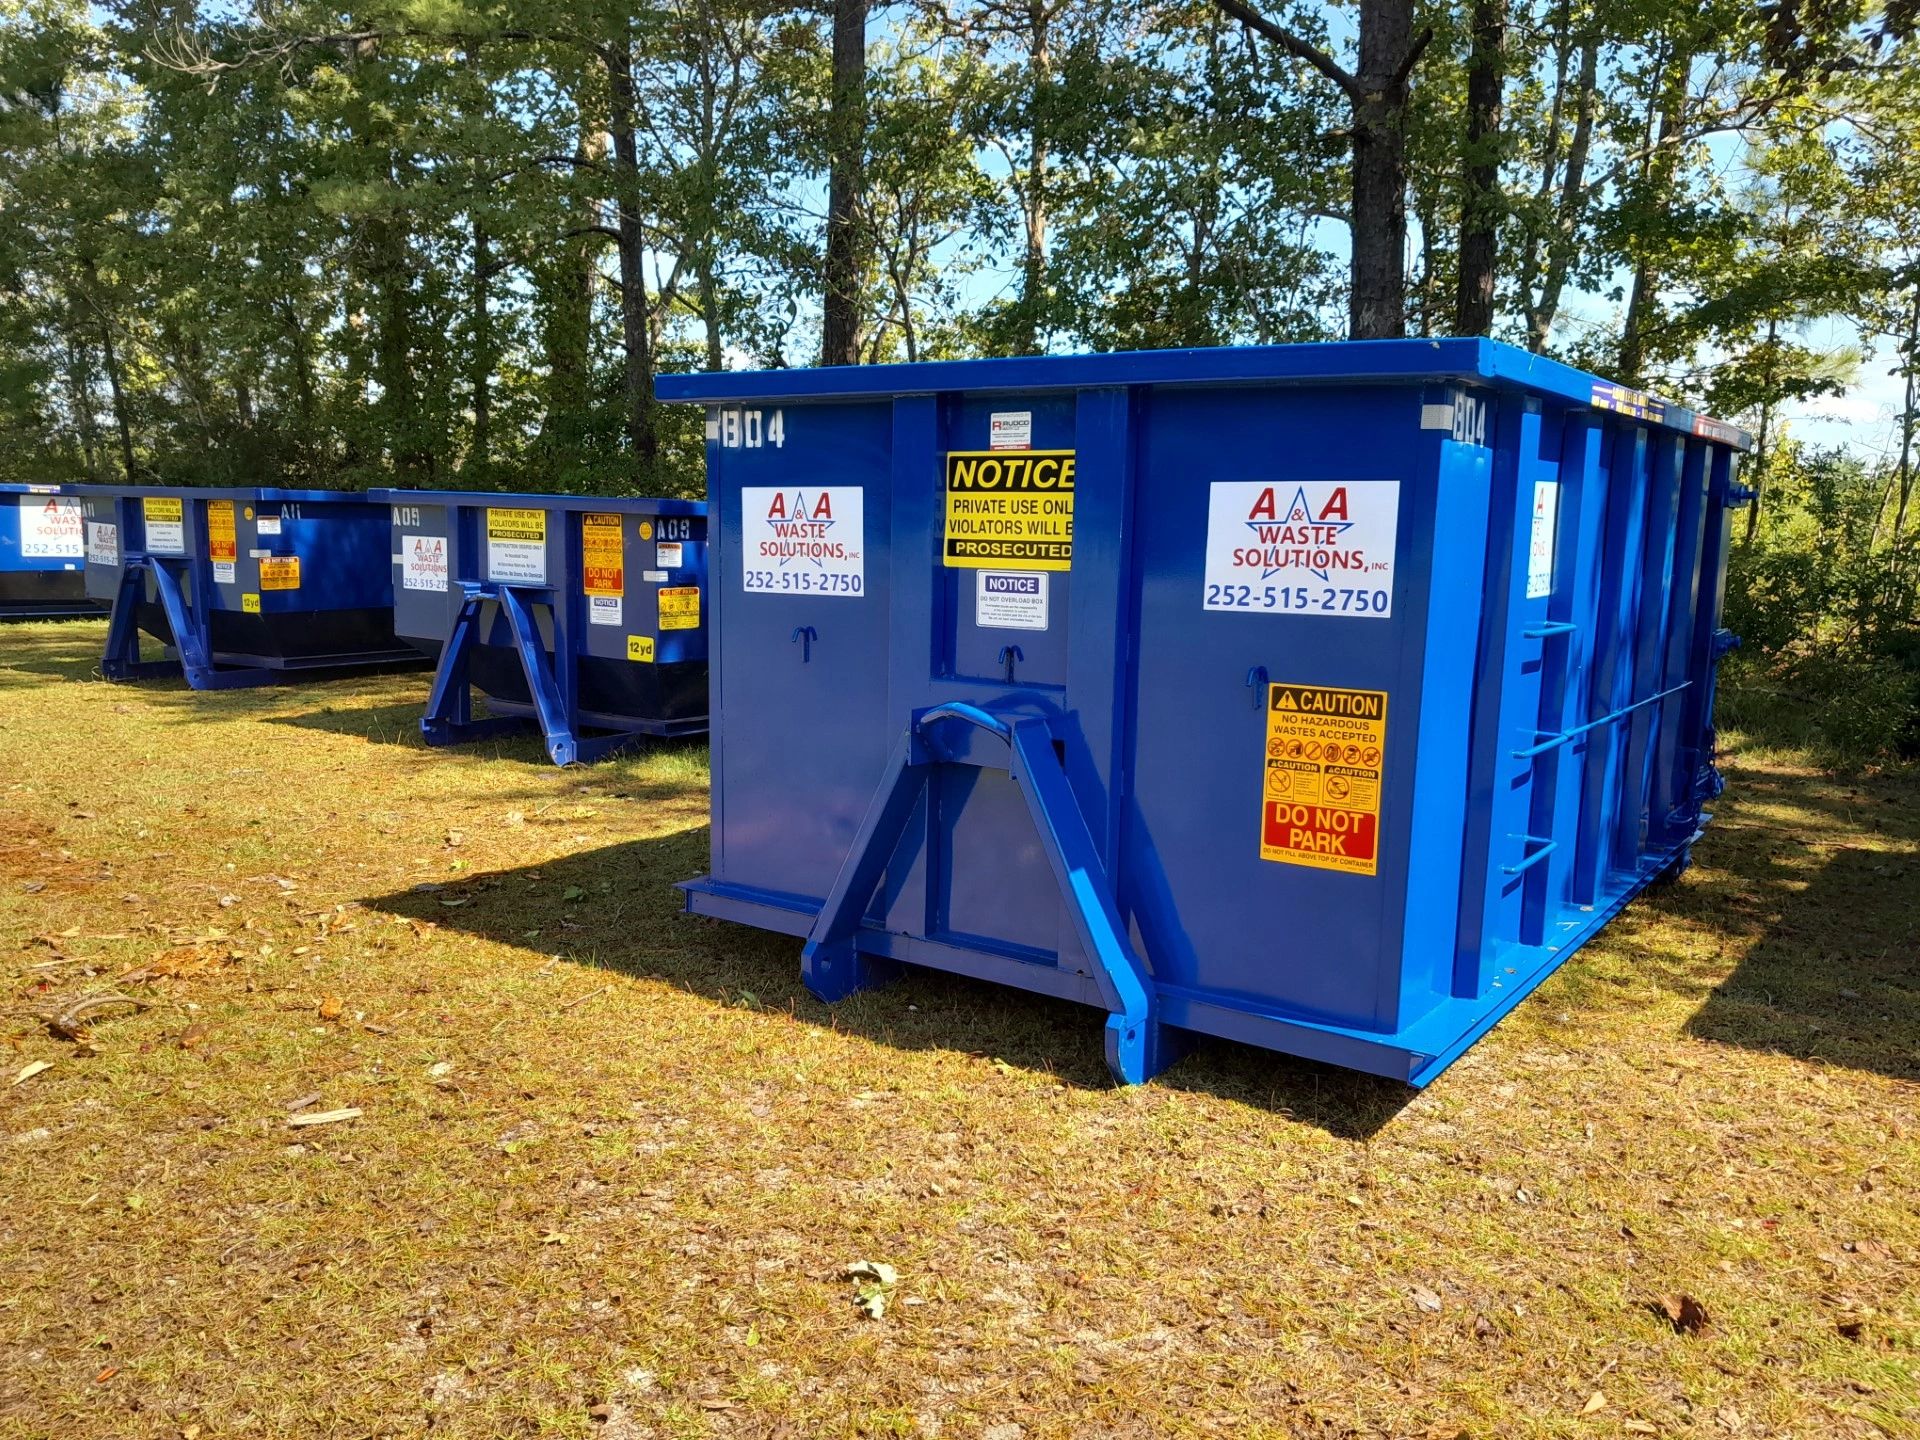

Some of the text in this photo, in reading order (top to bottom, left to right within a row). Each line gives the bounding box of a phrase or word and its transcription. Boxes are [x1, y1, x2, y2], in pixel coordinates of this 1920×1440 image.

[953, 459, 1075, 488] NOTICE
[44, 498, 58, 514] A
[768, 492, 832, 519] A & A
[954, 499, 1073, 515] PRIVATE USE ONL
[1249, 487, 1348, 521] A & A
[50, 516, 83, 524] WAST
[593, 515, 619, 525] CAUTION
[949, 519, 1022, 535] VIOLATORS
[1027, 521, 1060, 535] WILL
[774, 523, 826, 539] WASTE
[1258, 526, 1337, 546] WASTE
[25, 543, 79, 554] 252-515
[414, 539, 422, 551] A
[434, 540, 442, 553] A
[760, 541, 848, 561] SOLUTIONS,
[956, 542, 1072, 557] PROSECUTED
[1233, 548, 1388, 573] SOLUTIONS, INC
[588, 568, 618, 579] DO NOT
[746, 571, 861, 592] 252-515-2750
[594, 578, 613, 589] PARK
[989, 578, 1035, 591] NOTICE
[1207, 584, 1388, 612] 252-515-2750
[1300, 691, 1378, 716] CAUTION
[1282, 714, 1370, 731] NO HAZARDOUS
[1274, 725, 1377, 743] WASTES ACCEPTED
[1277, 761, 1318, 772] CAUTION
[1333, 767, 1376, 778] CAUTION
[1275, 803, 1364, 834] DO NOT
[1289, 828, 1346, 855] PARK
